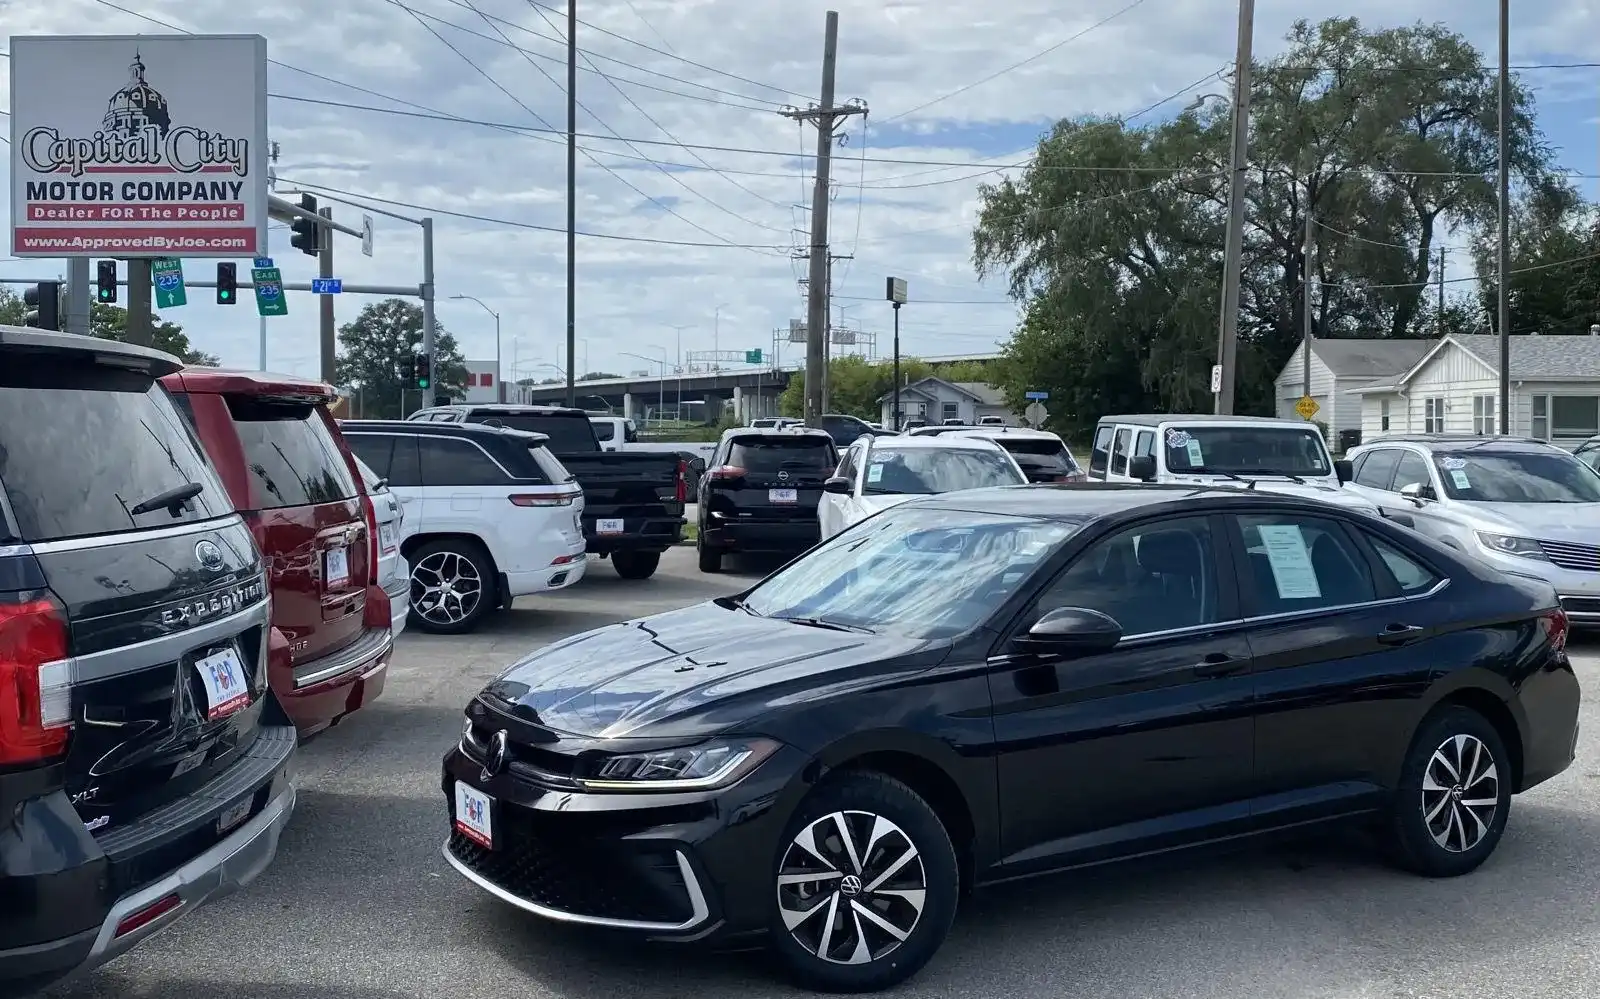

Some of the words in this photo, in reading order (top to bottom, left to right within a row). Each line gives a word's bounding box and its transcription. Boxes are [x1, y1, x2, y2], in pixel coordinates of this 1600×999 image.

[22, 126, 161, 178] Capital
[165, 126, 249, 177] City
[26, 181, 114, 201] MOTOR
[121, 181, 244, 201] COMPANY
[34, 206, 95, 218] Dealer
[101, 207, 134, 218] FOR
[140, 206, 172, 218] The
[177, 206, 238, 220] People
[23, 236, 247, 249] www.ApprovedByJoe.com
[154, 260, 177, 269] WEST
[160, 275, 179, 286] 235
[255, 271, 276, 279] EAST
[260, 285, 279, 295] 235
[72, 787, 100, 804] XLT
